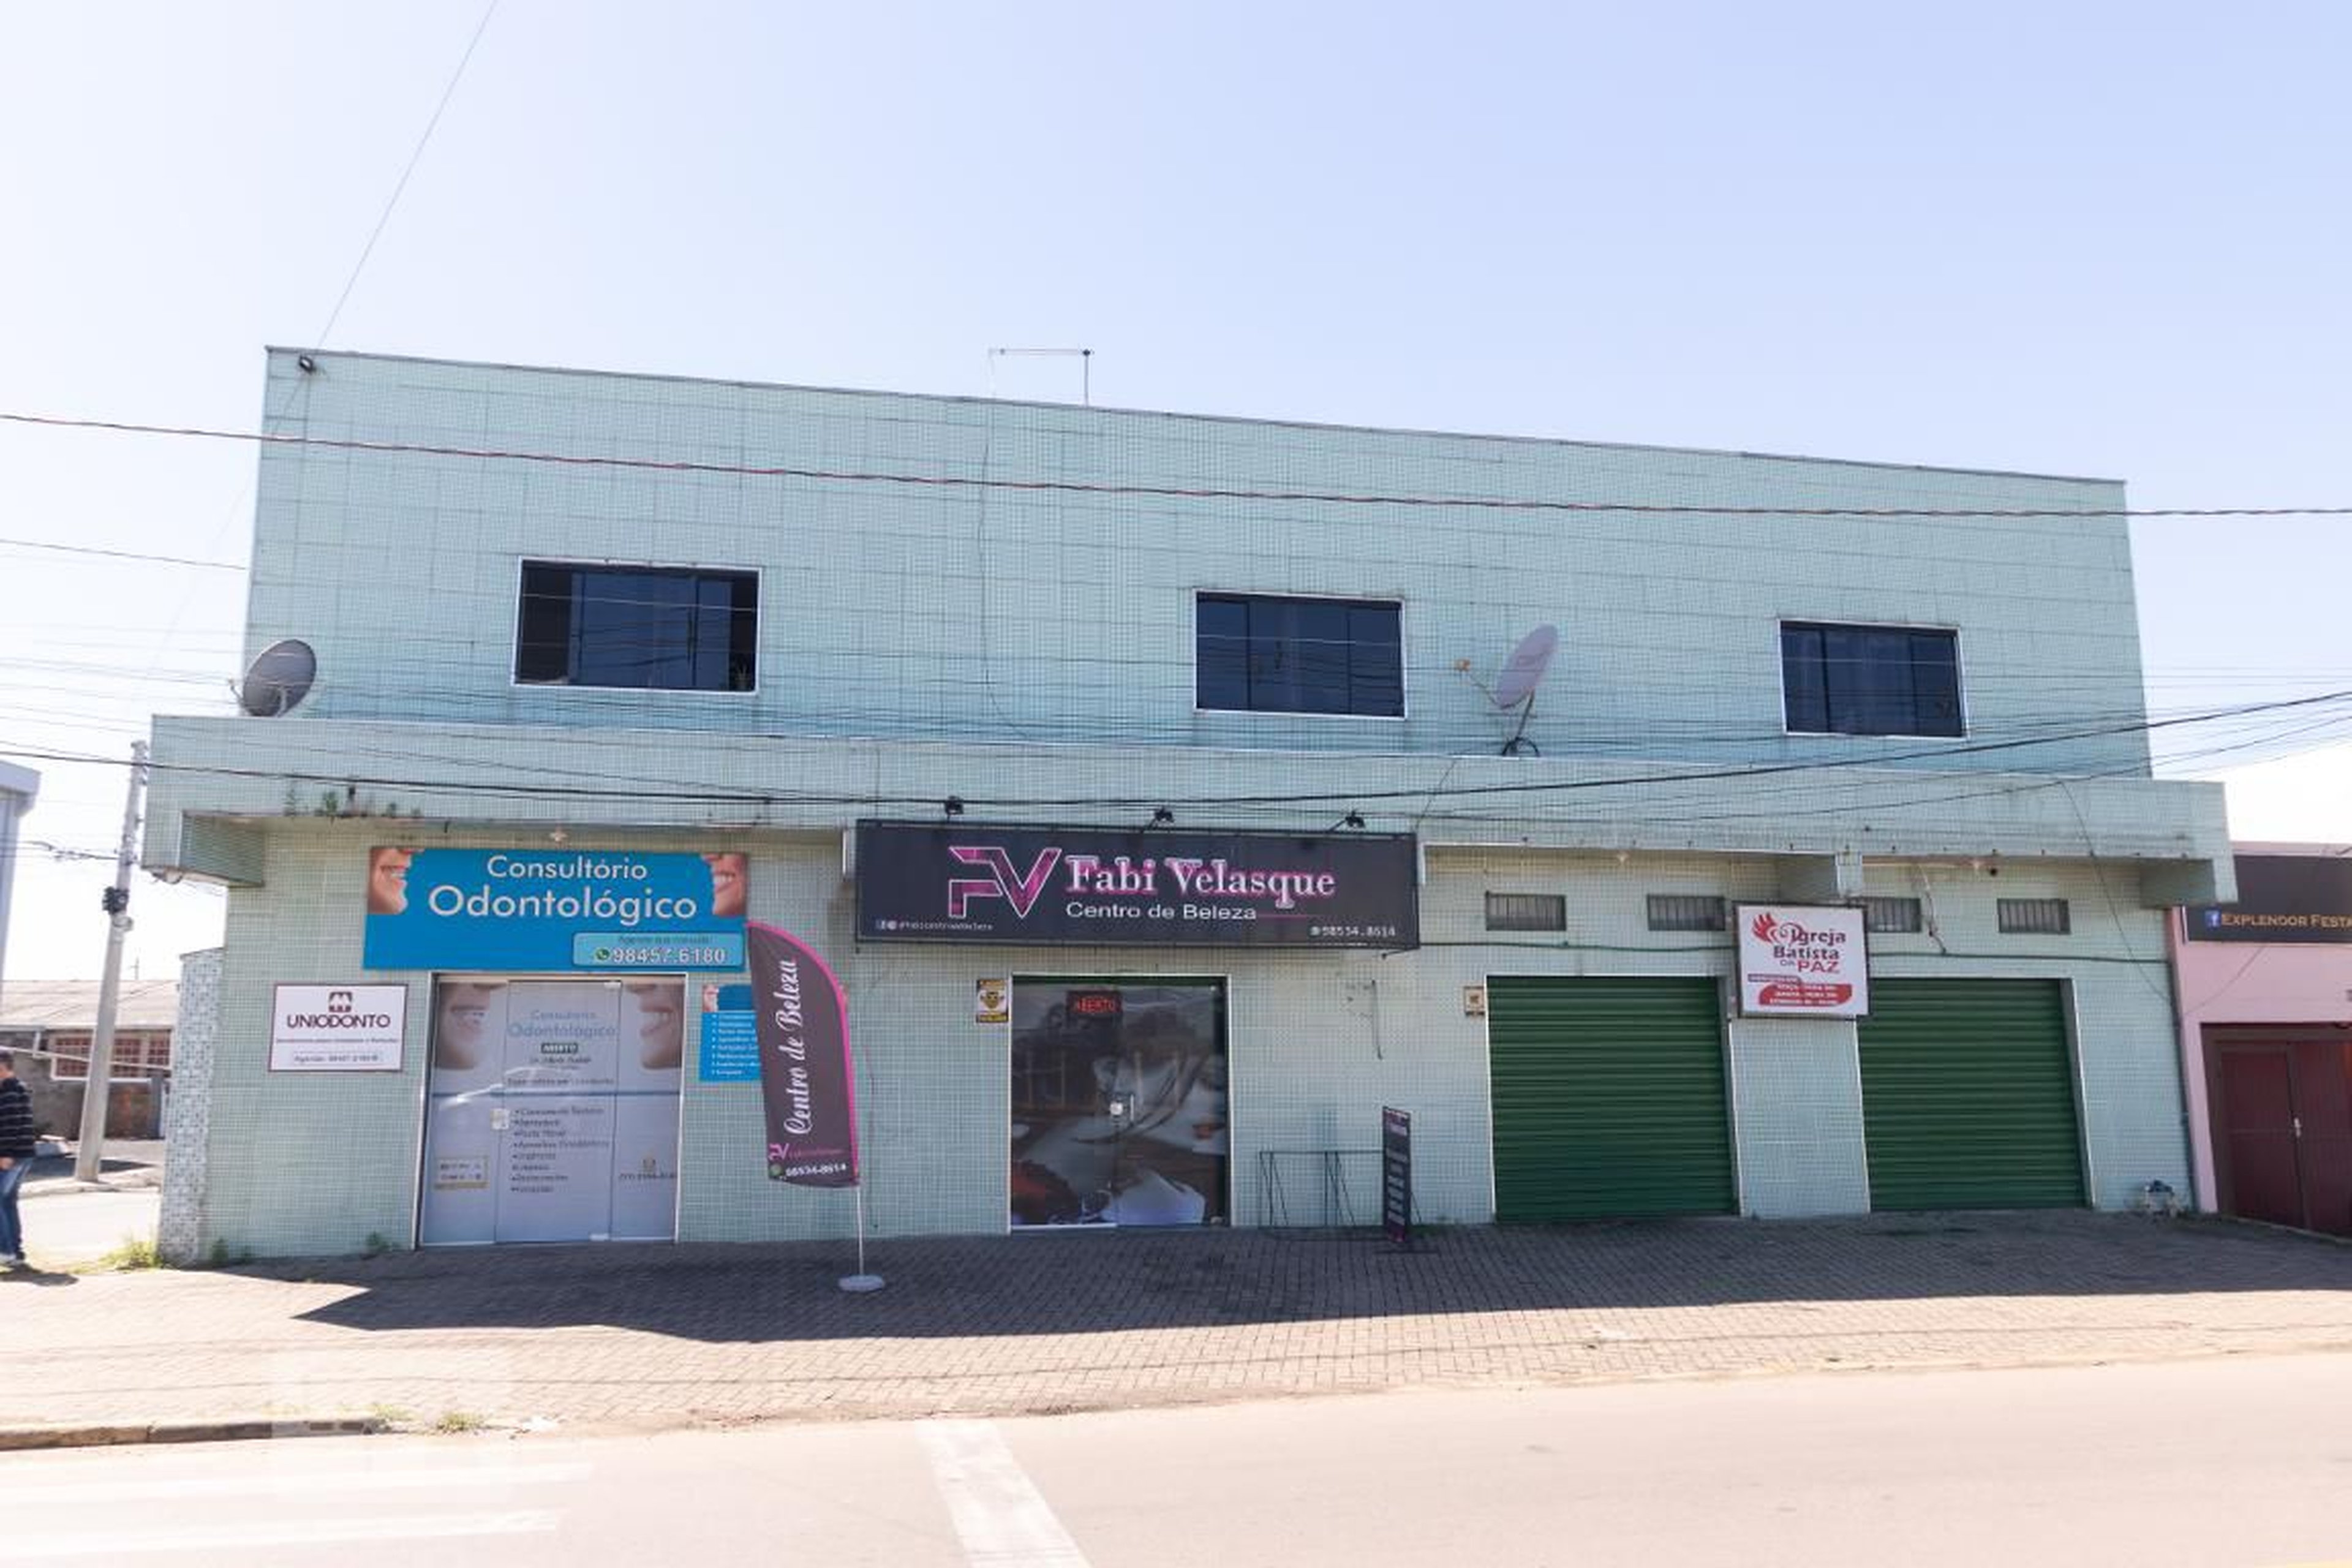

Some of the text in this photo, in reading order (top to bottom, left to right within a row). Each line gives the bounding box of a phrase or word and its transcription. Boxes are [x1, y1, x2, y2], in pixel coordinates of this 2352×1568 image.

[487, 854, 648, 881] Consultório
[1065, 854, 1335, 909] Fabi Velasque
[428, 884, 698, 926] Odontológico
[1065, 902, 1257, 921] Centro de Beleza
[2221, 913, 2308, 927] EXPLENDOR
[1790, 927, 1847, 947] Igreja
[1773, 944, 1840, 960] Batista
[1797, 959, 1840, 974] PAZ
[287, 1014, 391, 1028] UNIODONTO
[773, 959, 813, 1136] Centro de Beleza
